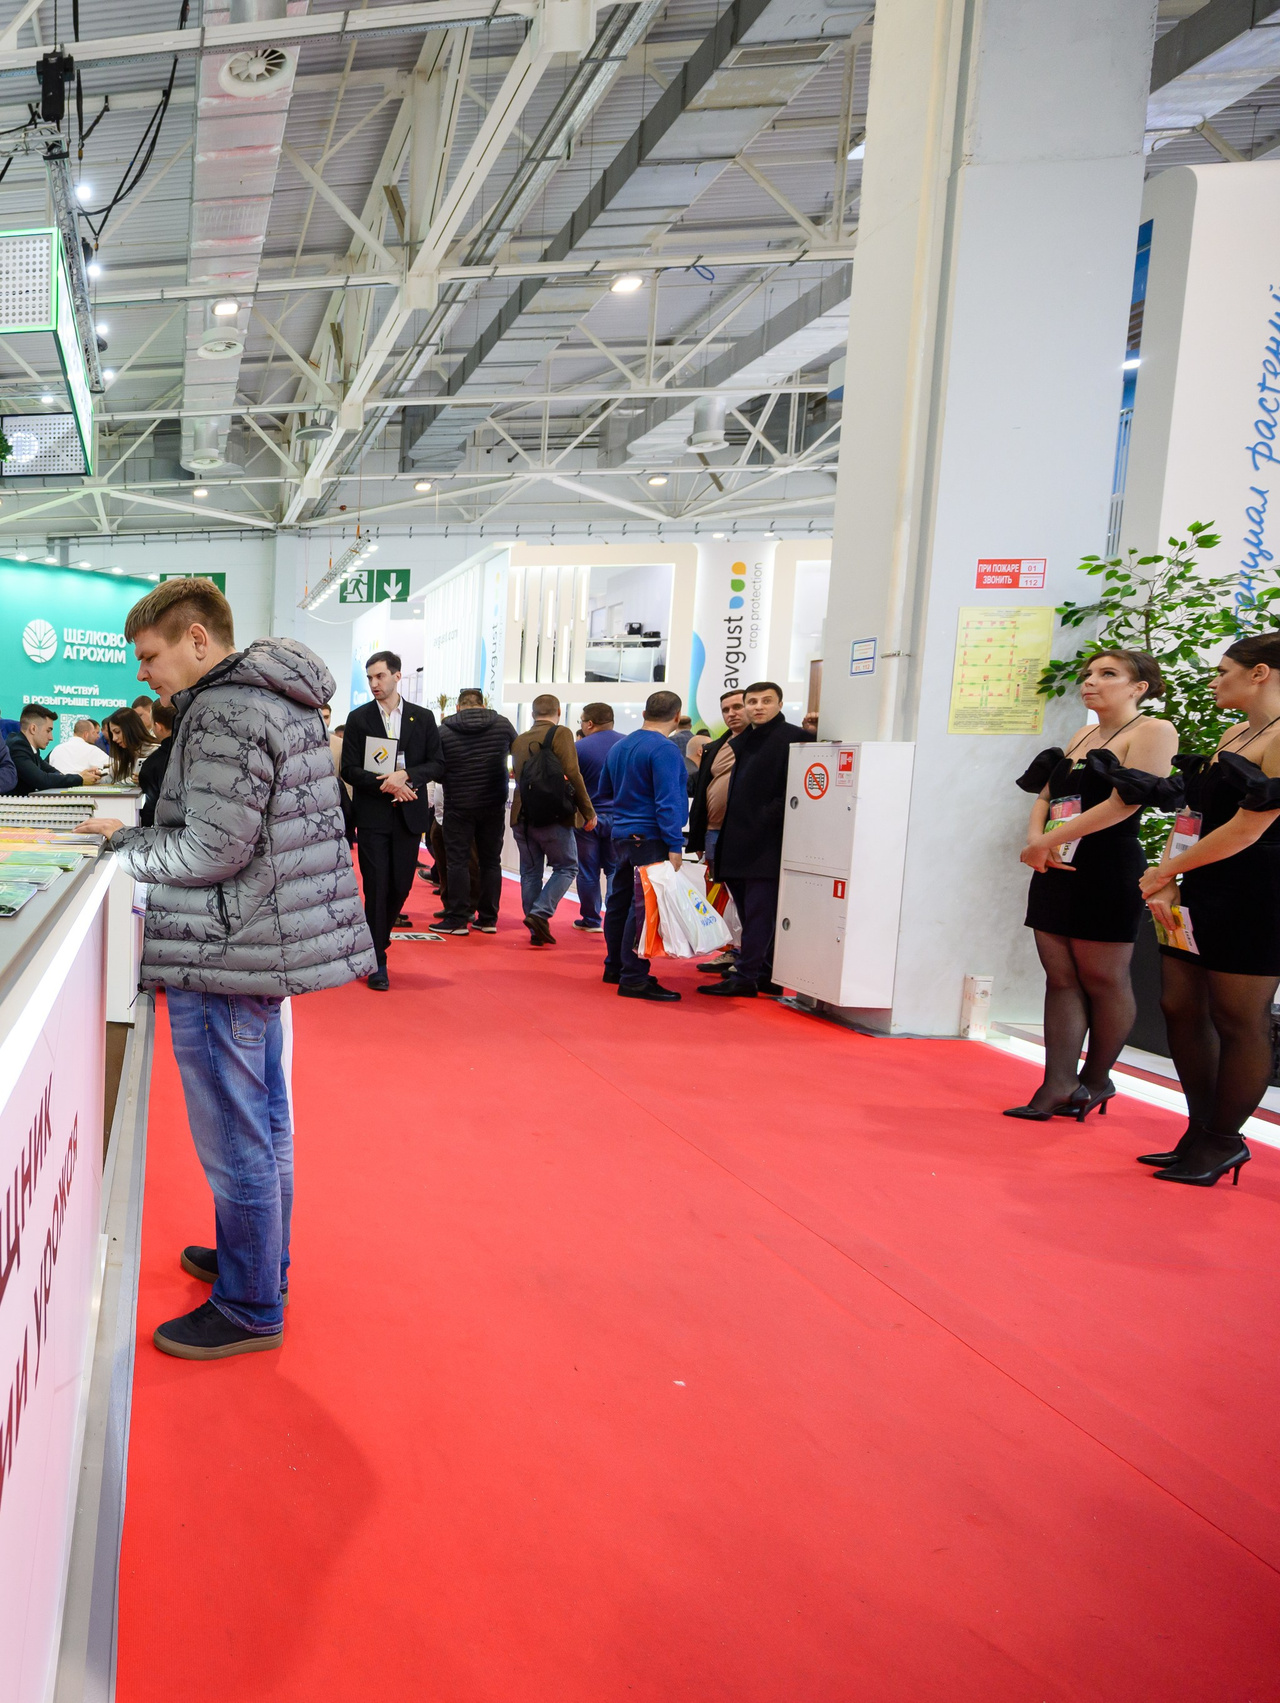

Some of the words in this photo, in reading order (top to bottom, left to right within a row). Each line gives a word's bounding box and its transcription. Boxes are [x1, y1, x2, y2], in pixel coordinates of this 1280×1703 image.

[978, 564, 991, 573] ПРИ
[992, 564, 1019, 573] ПОЖАРЕ
[982, 575, 1013, 585] ЗВОНИТЬ
[750, 562, 763, 621] protection
[63, 628, 126, 648] ЩЕЛКОВО
[749, 624, 761, 649] crop
[63, 645, 126, 664] АГРОХИМ
[724, 615, 746, 689] avgust
[53, 685, 99, 696] УЧАСТВУЙ
[23, 695, 30, 704] В
[31, 696, 90, 707] РОЗЫГРЫШЕ
[90, 698, 127, 708] ПРИЗОВ!
[33, 1109, 78, 1390] урожая
